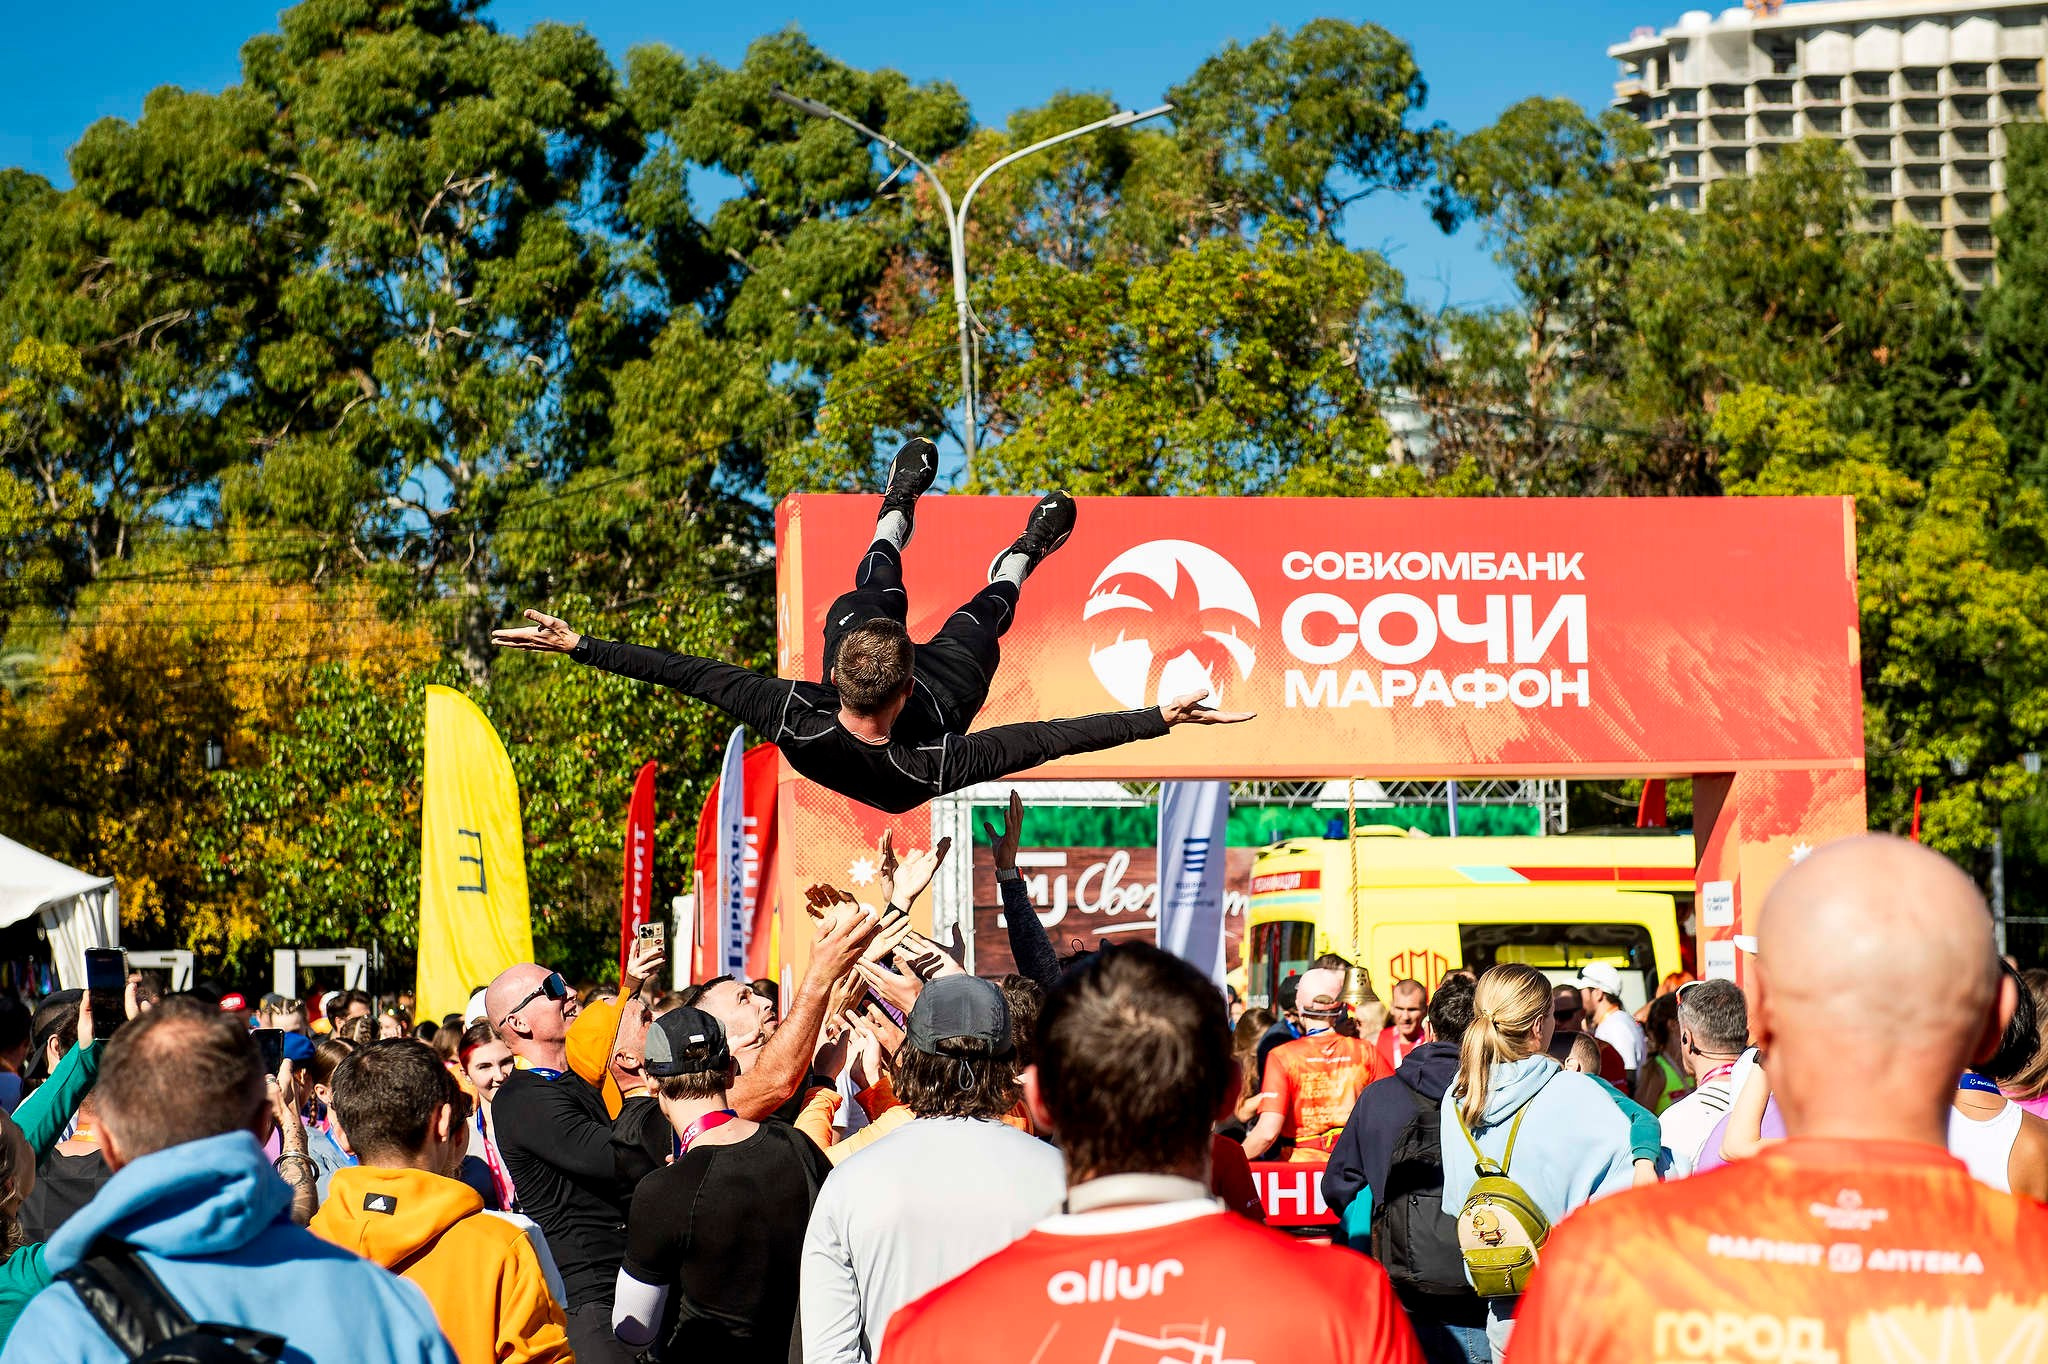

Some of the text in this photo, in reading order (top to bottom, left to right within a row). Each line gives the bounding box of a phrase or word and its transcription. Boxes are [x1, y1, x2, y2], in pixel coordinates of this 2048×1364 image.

[1282, 551, 1585, 581] СОВКОМБАНК
[1281, 592, 1588, 665] СОЧИ
[1284, 668, 1590, 708] МАРАФОН
[1046, 1258, 1184, 1305] allur
[1866, 1248, 1985, 1275] АПТЕКА
